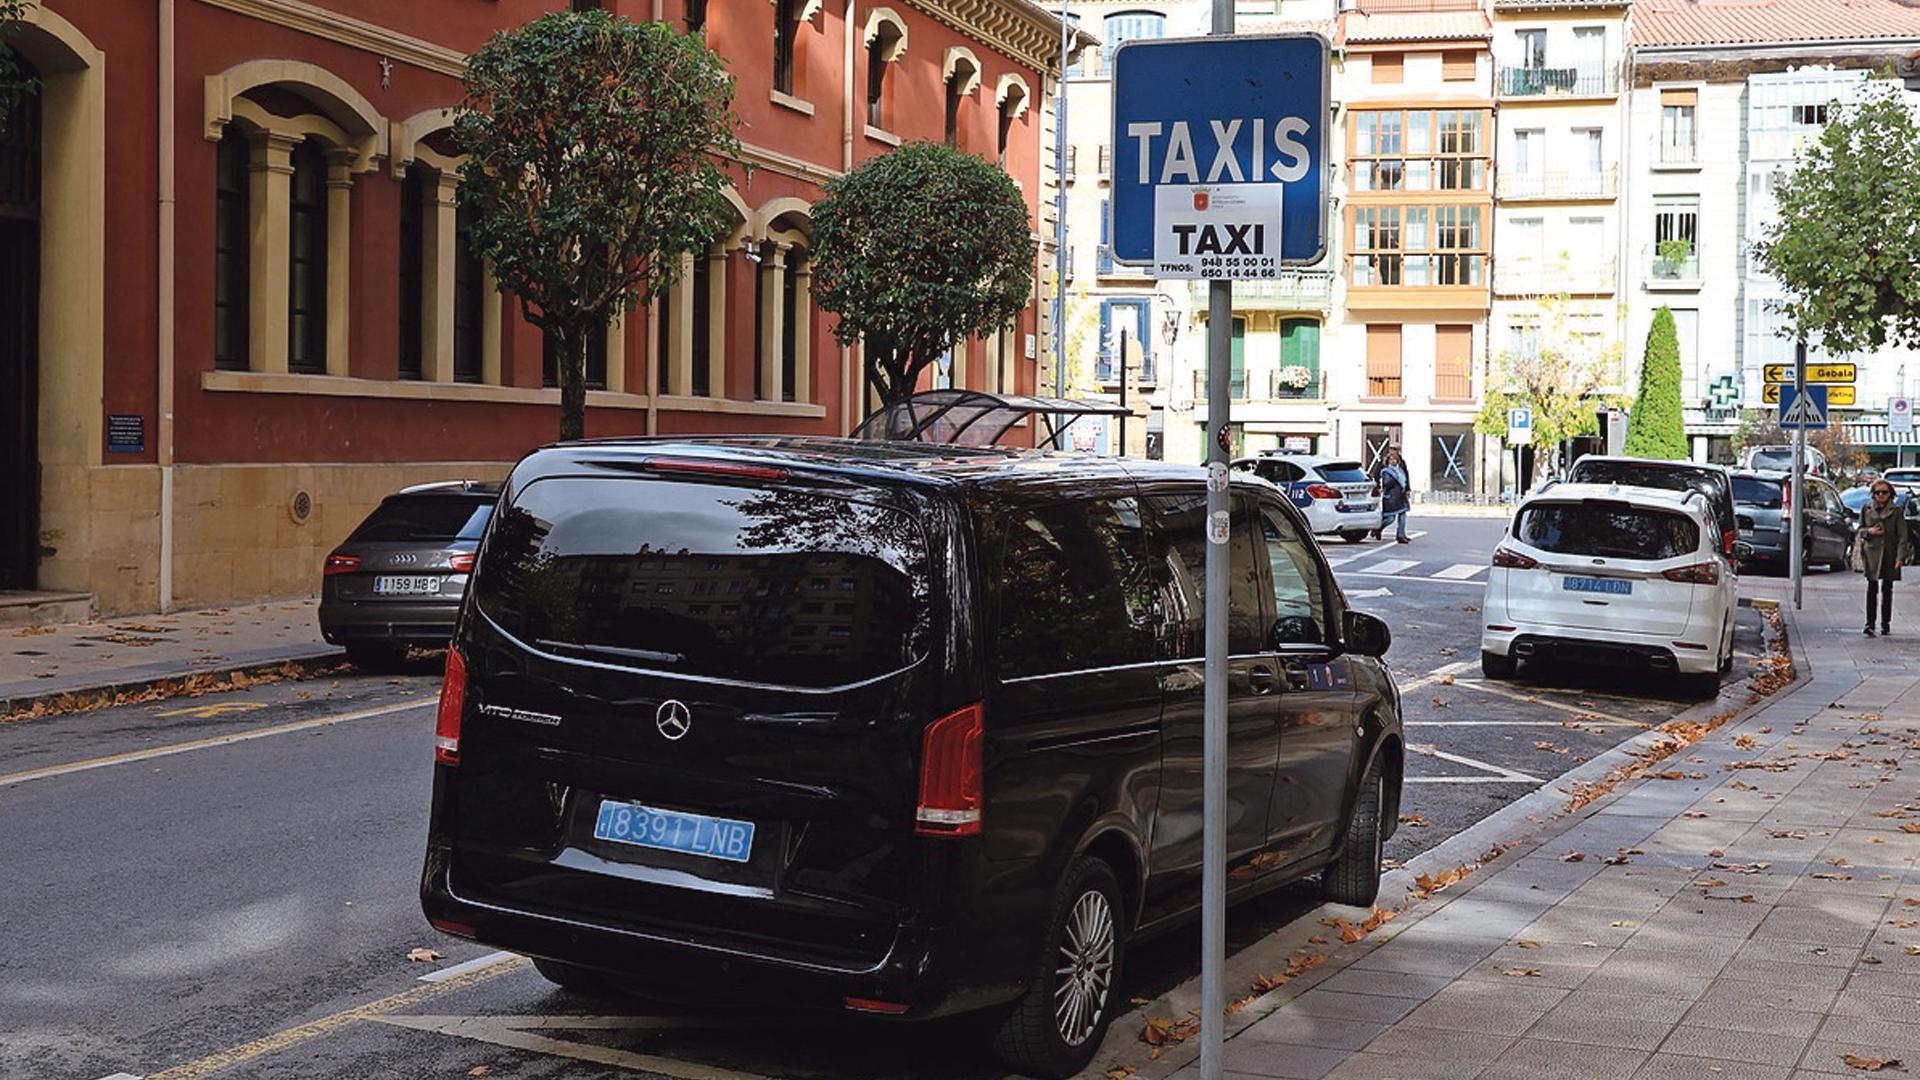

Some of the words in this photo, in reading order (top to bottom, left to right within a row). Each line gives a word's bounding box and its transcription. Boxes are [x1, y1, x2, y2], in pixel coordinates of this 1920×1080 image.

[1128, 116, 1311, 184] TAXIS
[1172, 224, 1264, 255] TAXI
[1159, 263, 1194, 273] TFNOS:
[1201, 257, 1222, 267] 948
[1226, 257, 1240, 267] 55
[1243, 257, 1258, 267] 00
[1261, 257, 1274, 267] 01
[1201, 268, 1222, 278] 650
[1227, 268, 1240, 278] 14
[1243, 268, 1258, 278] 44
[1261, 268, 1276, 278] 66
[1817, 368, 1853, 378] Gebala
[1515, 412, 1525, 426] P
[384, 578, 411, 590] 1159
[614, 808, 683, 846] 8391
[691, 818, 746, 855] LNB
